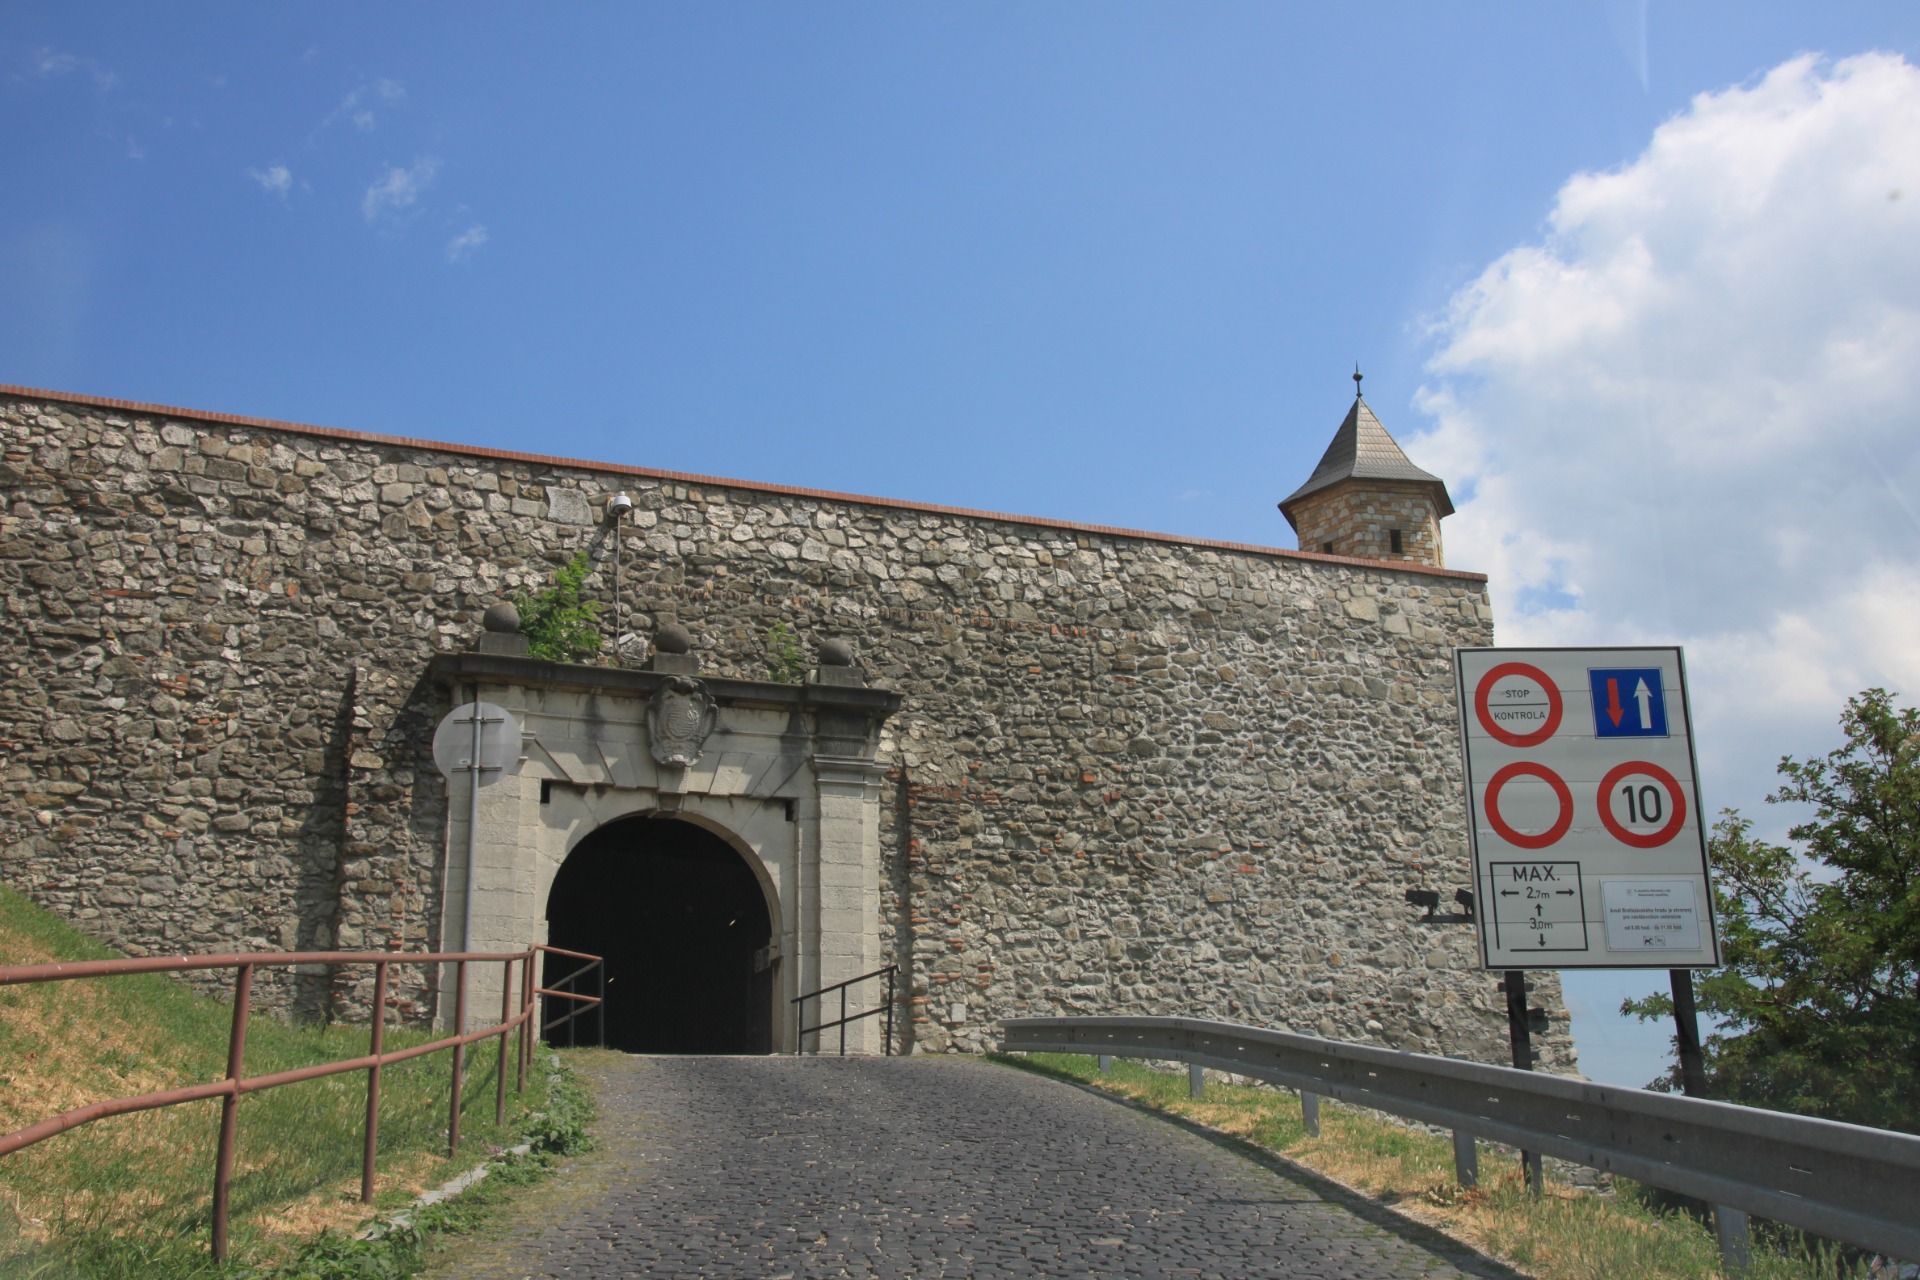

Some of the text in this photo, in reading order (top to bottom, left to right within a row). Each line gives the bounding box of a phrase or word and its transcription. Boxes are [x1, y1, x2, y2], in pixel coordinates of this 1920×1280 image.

[1505, 689, 1530, 698] STOP
[1494, 711, 1546, 720] KONTROLA
[1622, 785, 1662, 824] 10
[1512, 865, 1560, 882] MAX.
[1526, 886, 1550, 899] 2,7m
